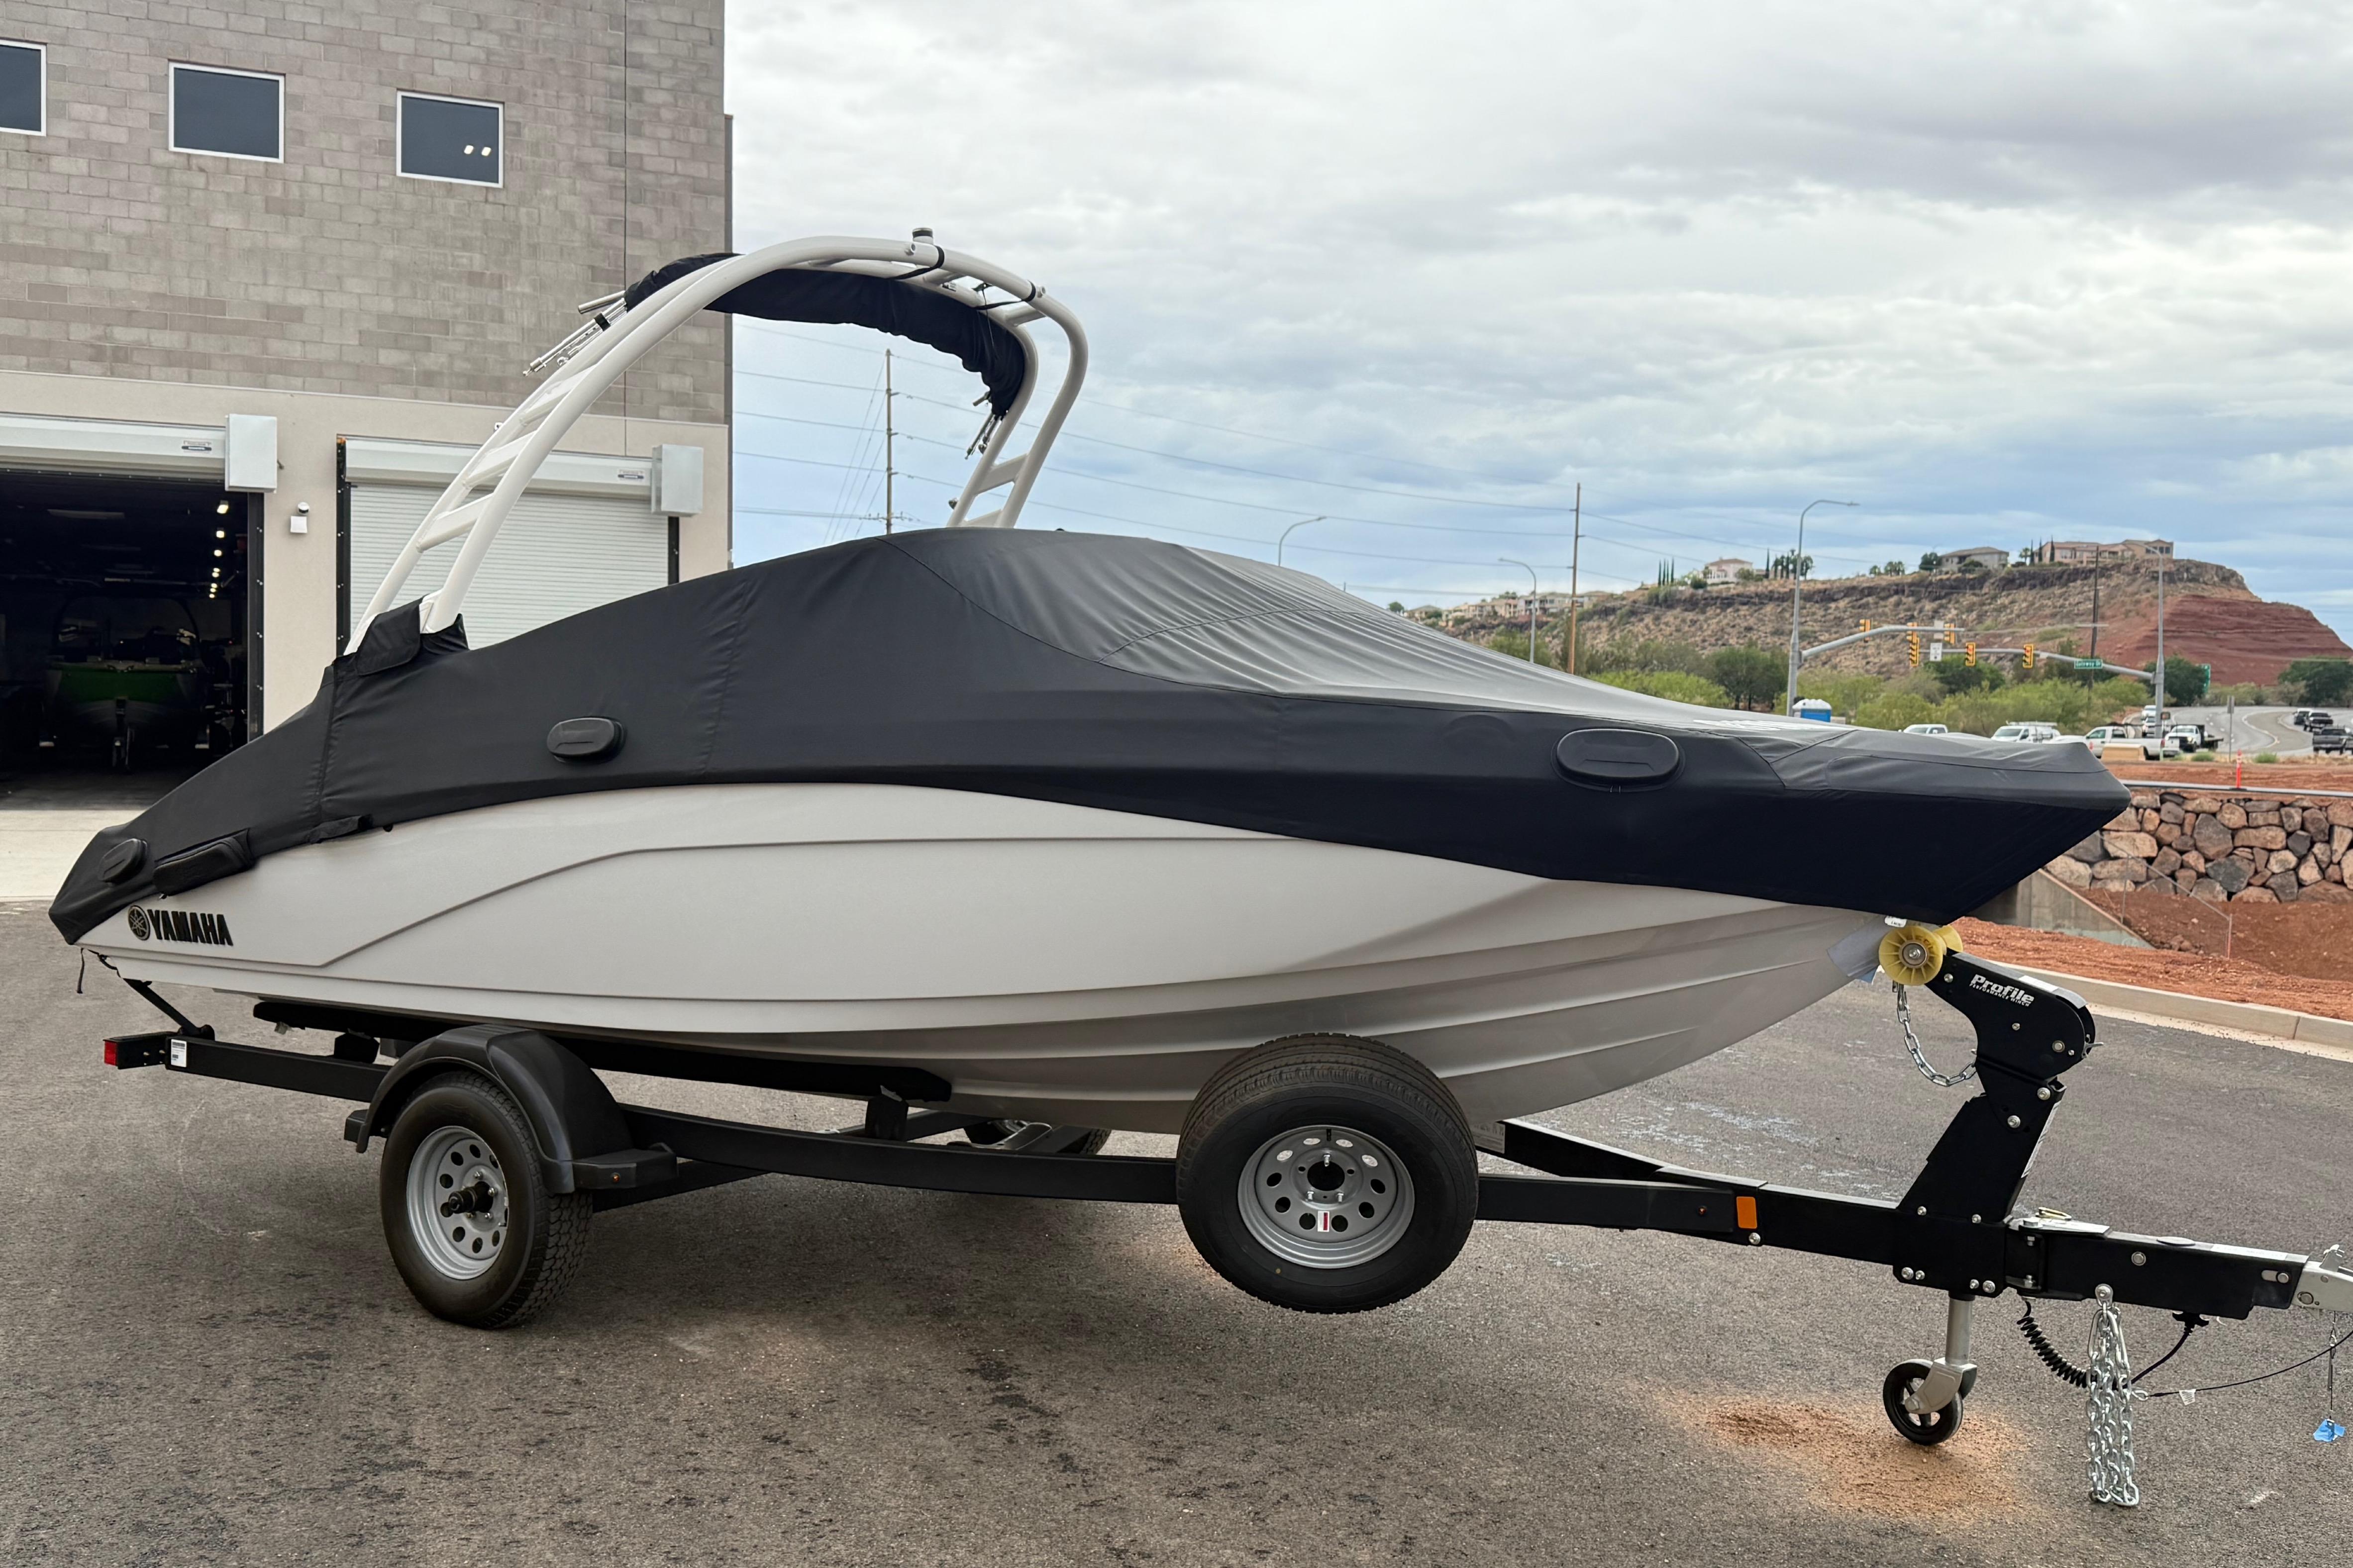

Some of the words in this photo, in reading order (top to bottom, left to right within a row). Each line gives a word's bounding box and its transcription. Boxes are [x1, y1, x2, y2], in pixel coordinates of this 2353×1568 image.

[147, 909, 234, 946] YAMAHA
[1970, 974, 2035, 1004] Profile
[2010, 997, 2030, 1007] WINCH
